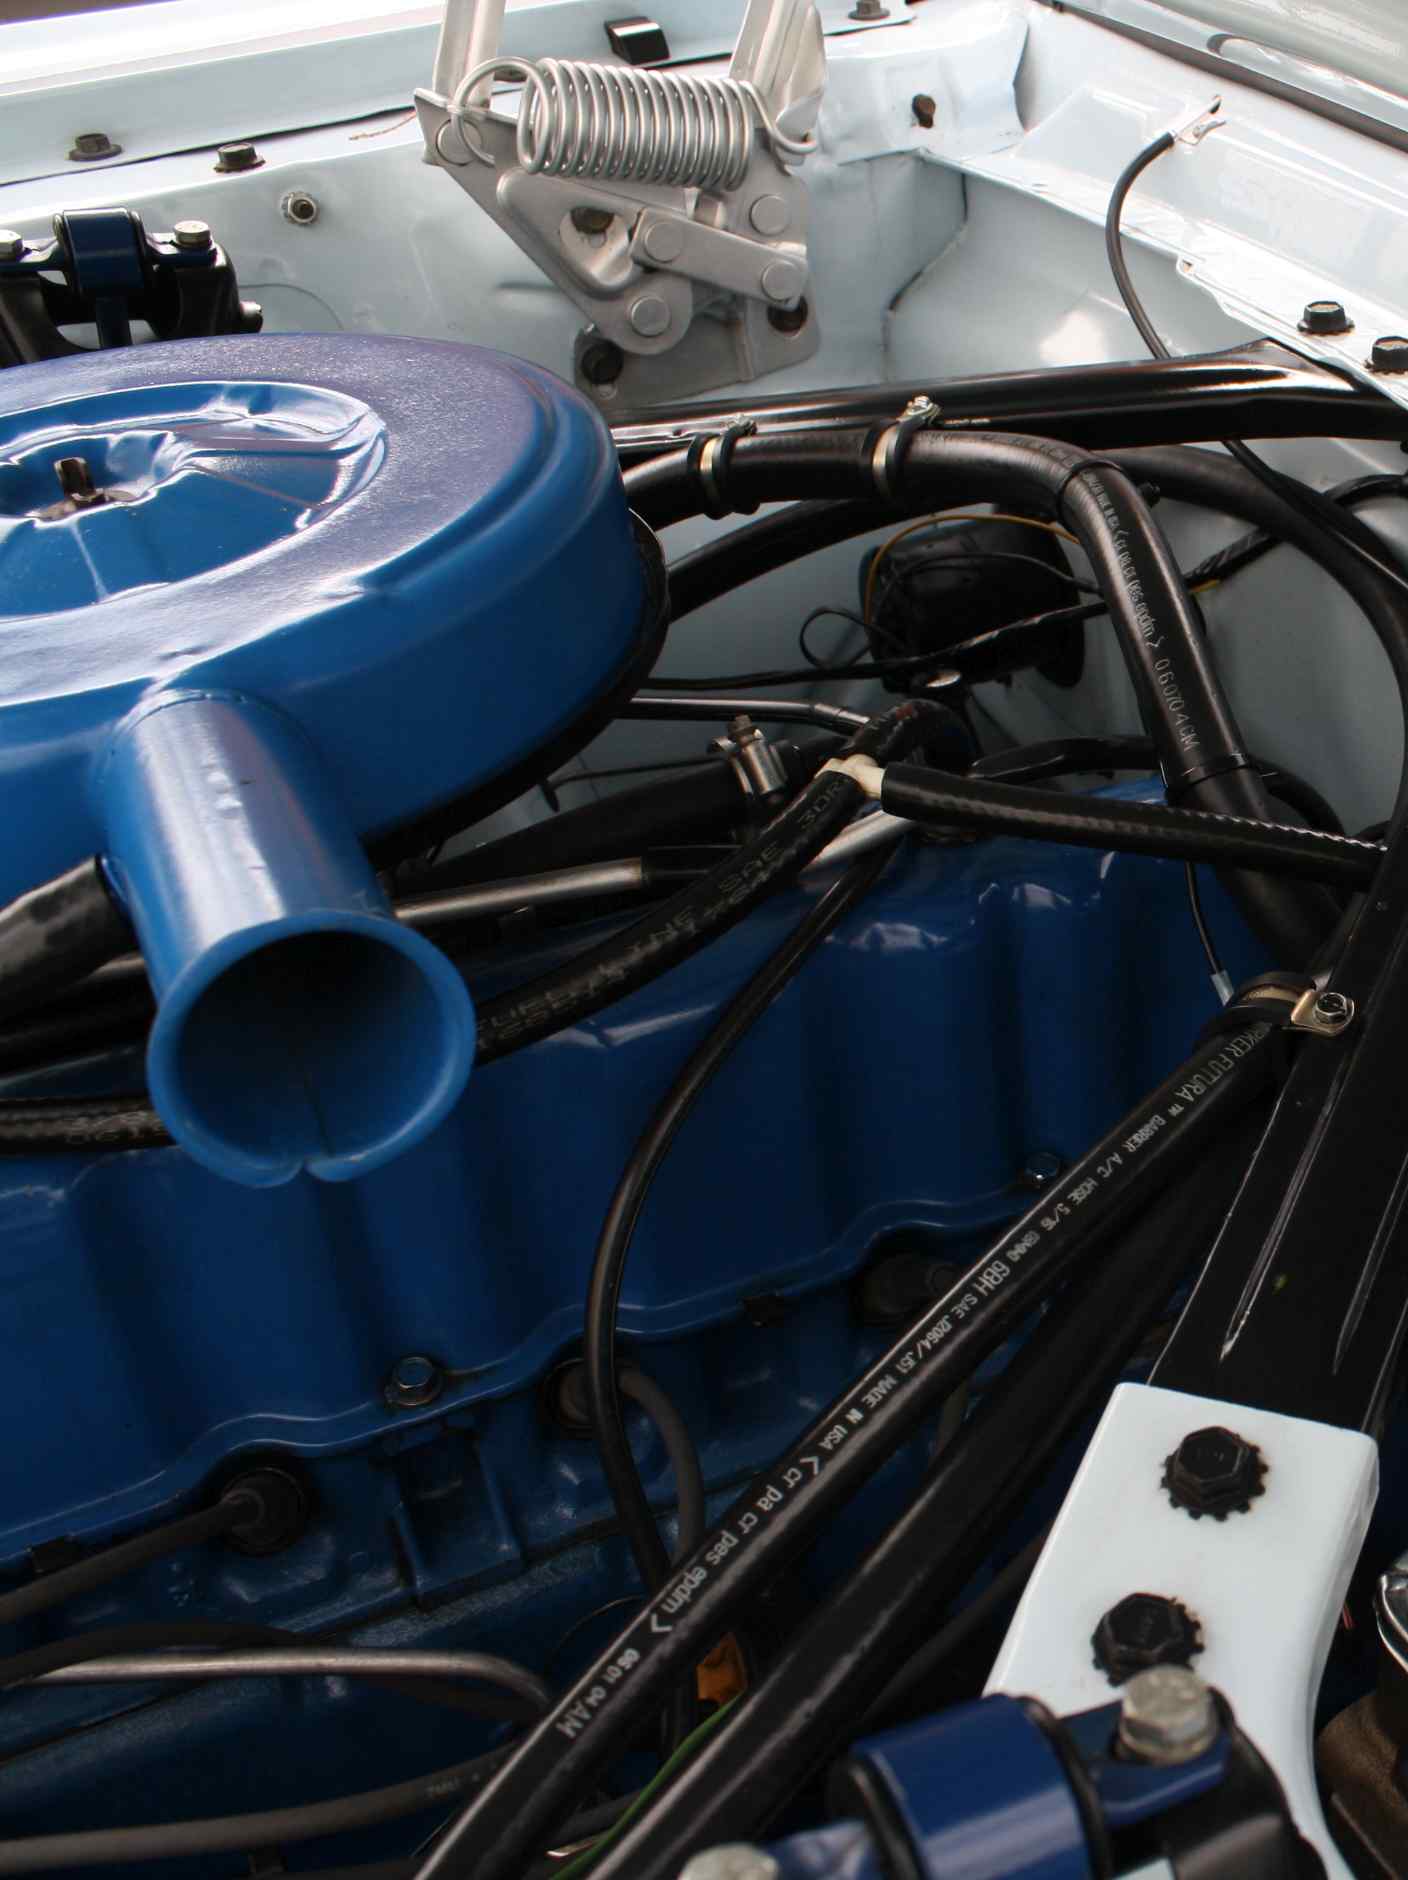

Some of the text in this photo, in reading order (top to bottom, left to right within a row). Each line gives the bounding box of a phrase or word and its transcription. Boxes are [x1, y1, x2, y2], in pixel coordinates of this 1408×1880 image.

[1173, 1051, 1233, 1106] FUTURA
[1120, 1112, 1167, 1154] BARRIER
[1094, 1150, 1125, 1178] A/C
[1065, 1175, 1098, 1205] HOSE
[970, 1256, 1012, 1297] 6BH
[948, 1289, 978, 1319] SAE
[859, 1371, 897, 1409] MADE
[843, 1406, 864, 1425] IN
[817, 1422, 848, 1453] USA
[754, 1483, 784, 1514] pa
[702, 1528, 740, 1569] pes
[658, 1562, 711, 1619] epdm
